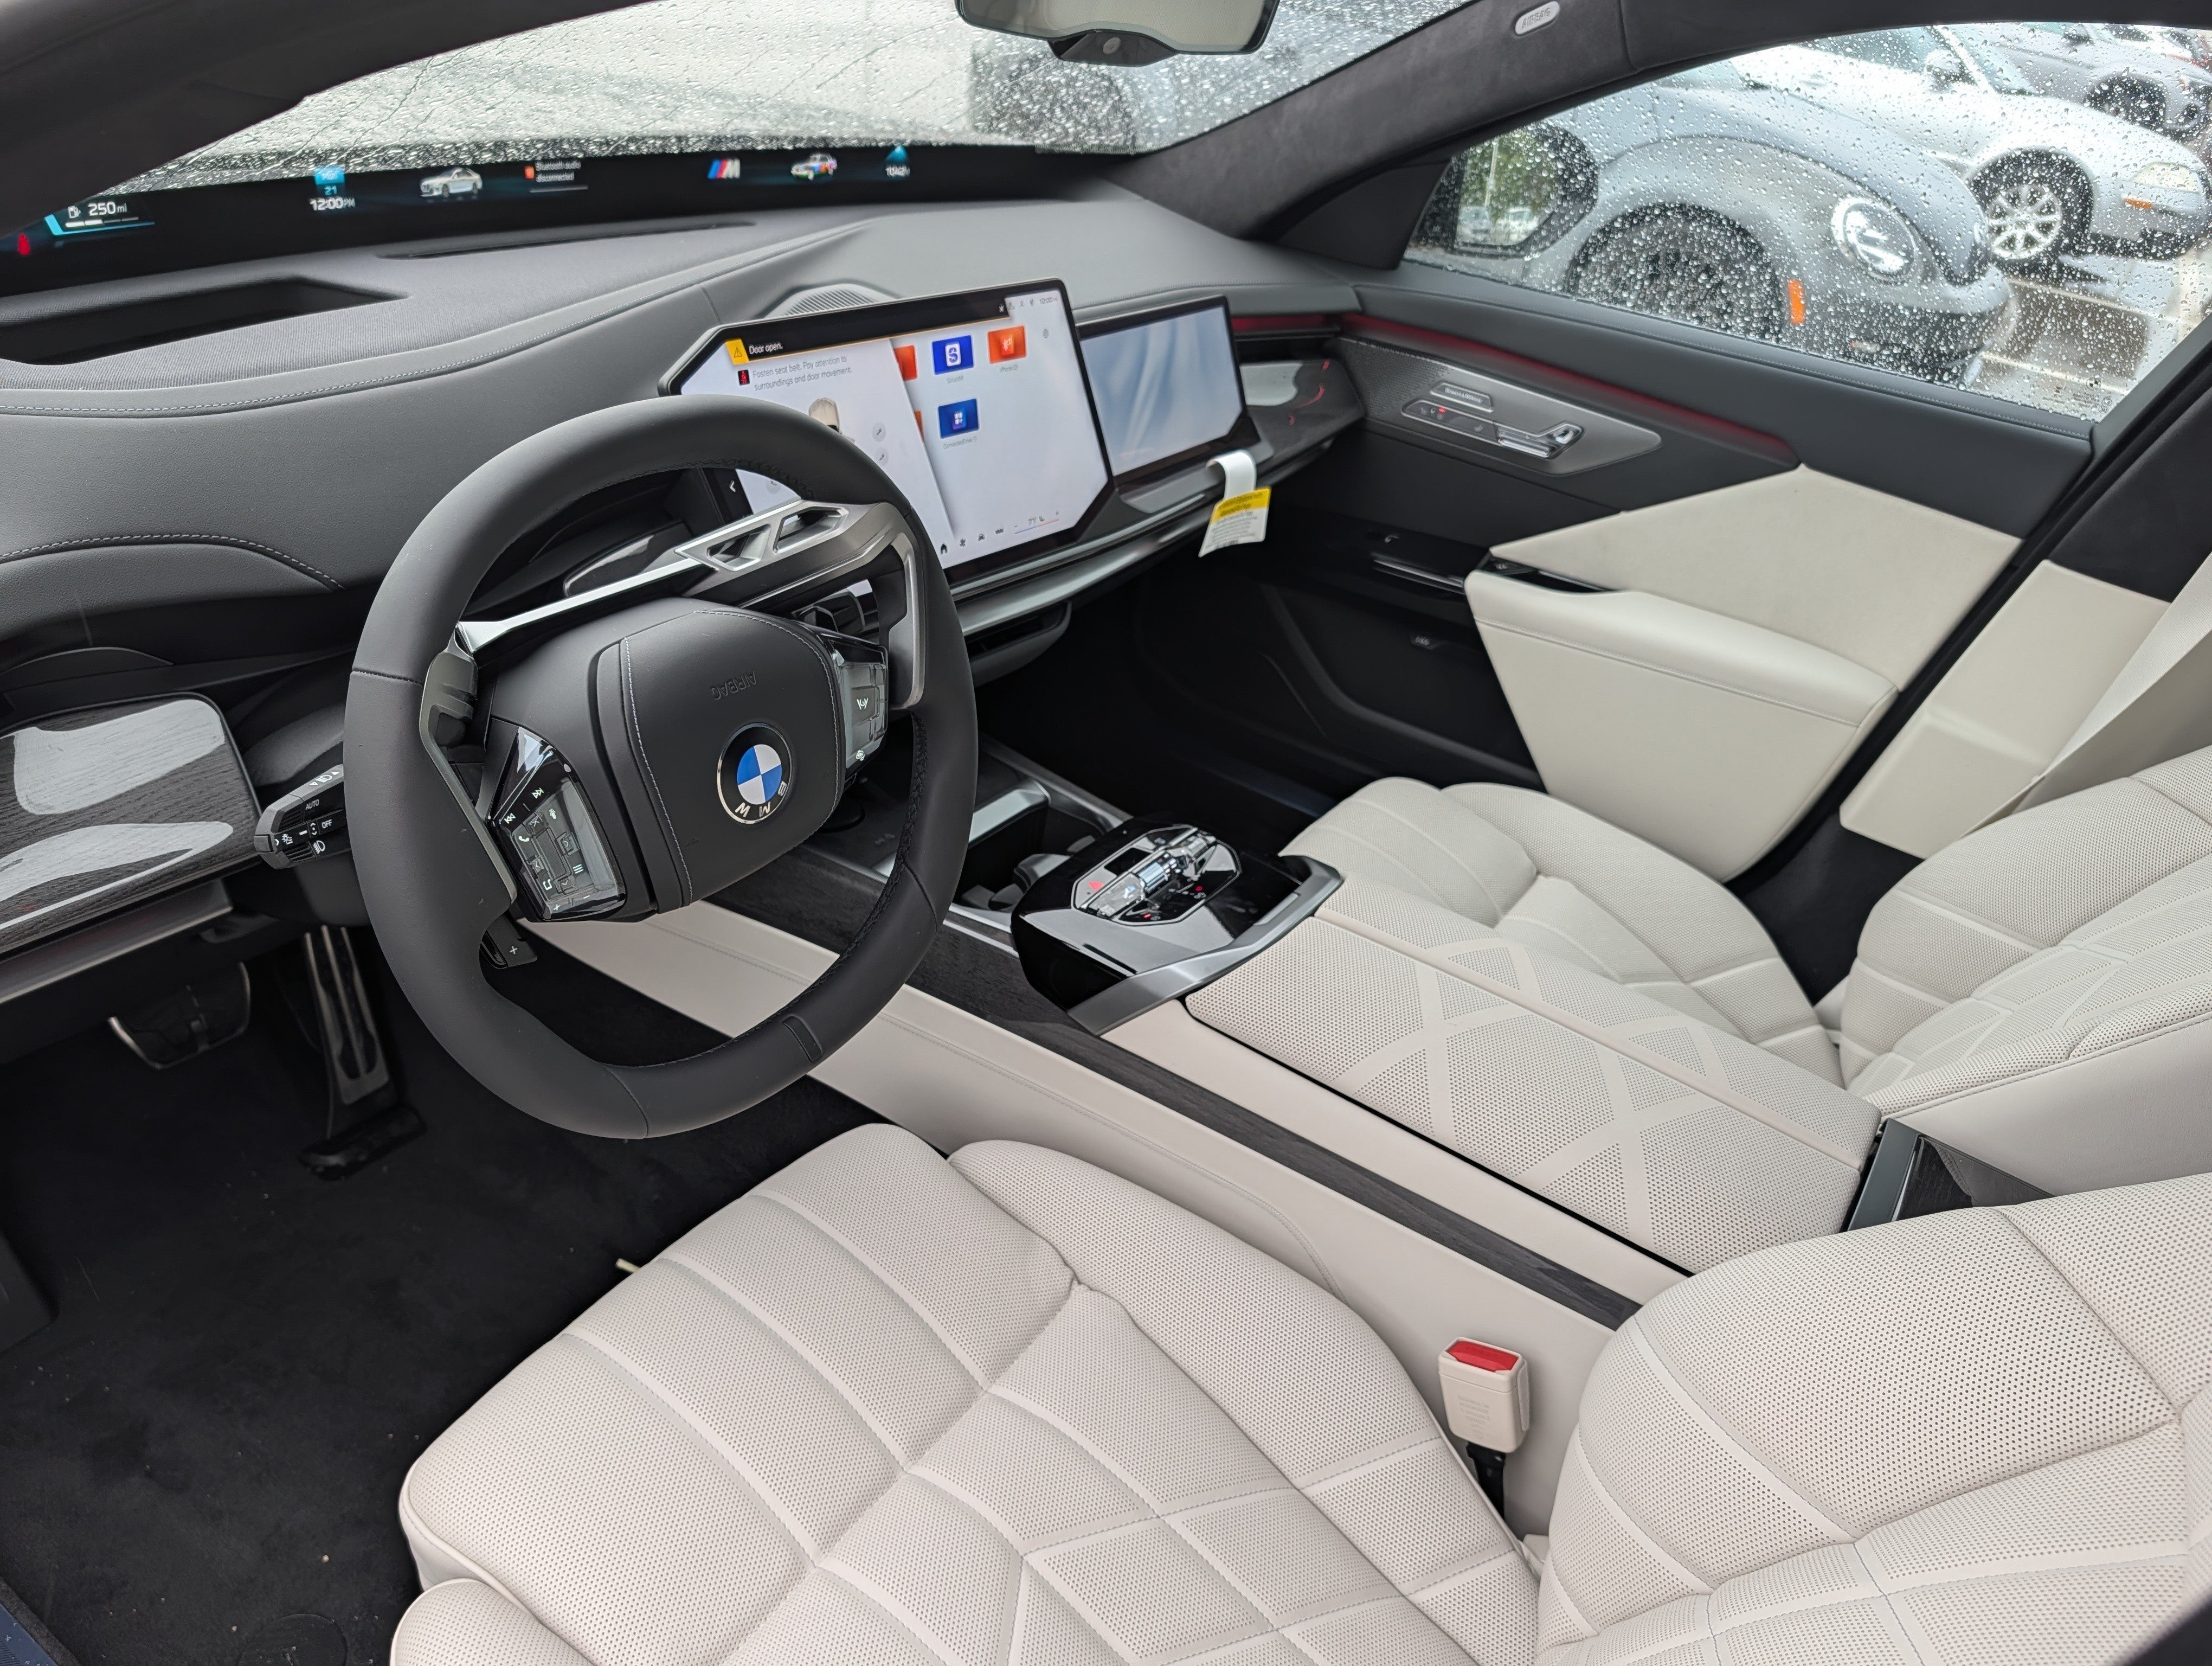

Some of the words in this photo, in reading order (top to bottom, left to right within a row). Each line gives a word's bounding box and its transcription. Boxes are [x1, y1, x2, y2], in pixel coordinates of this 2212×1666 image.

[1521, 7, 1551, 29] AIRBAG
[535, 161, 563, 171] Bluetooth
[536, 171, 574, 182] disconnected
[324, 185, 337, 195] 21
[749, 343, 764, 354] Door
[765, 341, 783, 353] open.
[753, 370, 774, 379] Fasten
[775, 366, 788, 375] seat
[802, 360, 814, 370] Pay
[815, 357, 840, 368] attention
[754, 378, 793, 391] surroundings
[794, 374, 806, 383] and
[807, 372, 820, 382] door
[711, 671, 756, 700] AIRBAG
[306, 799, 319, 810] AUTO
[735, 780, 787, 818] BMW
[321, 819, 332, 829] OFF
